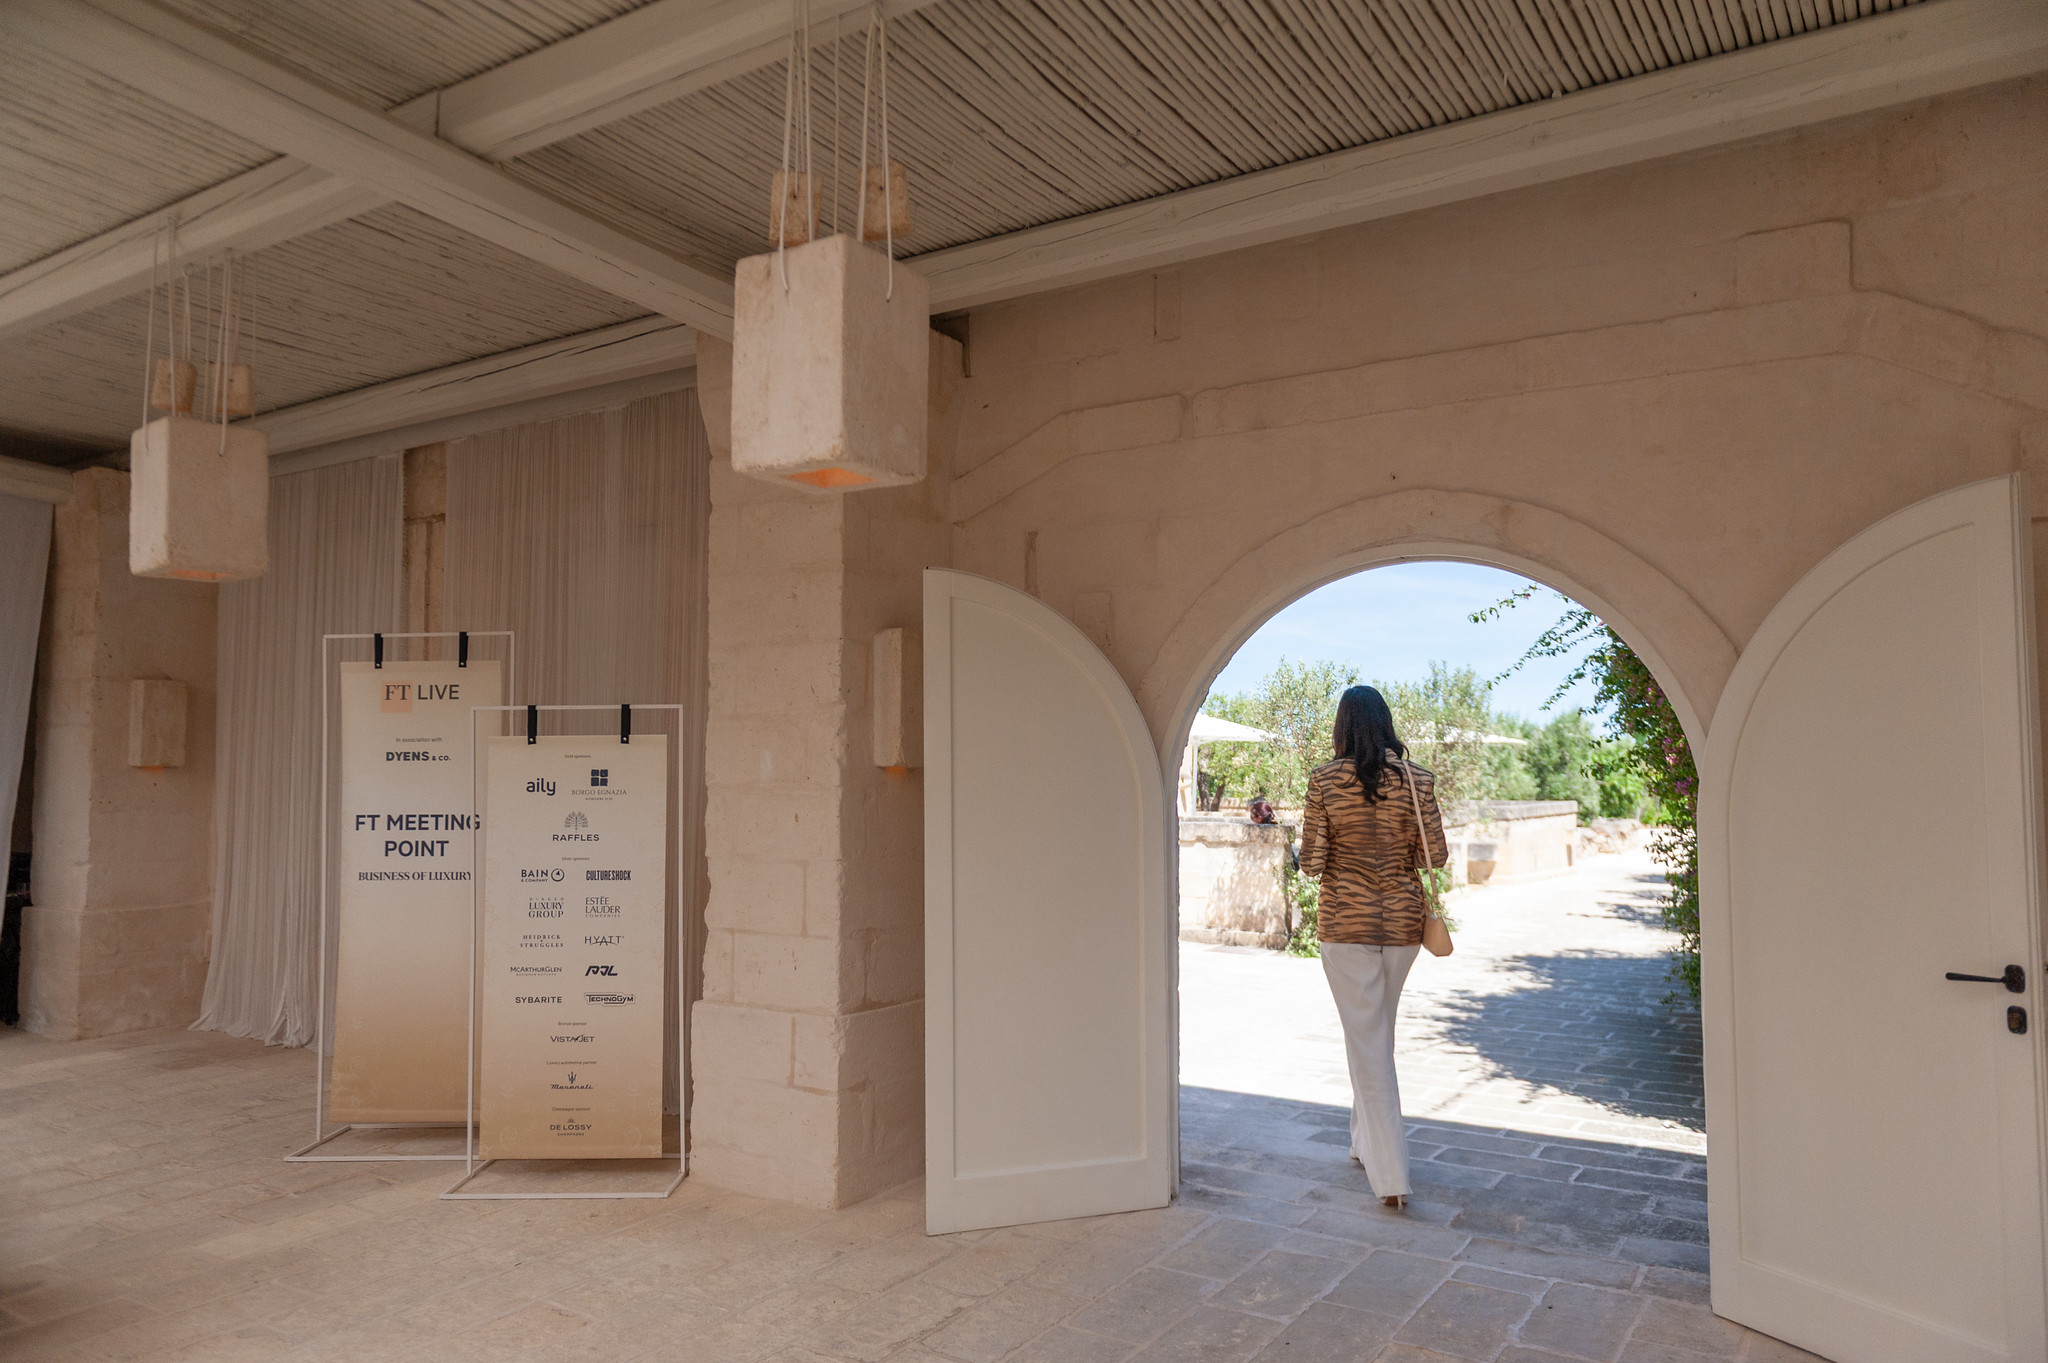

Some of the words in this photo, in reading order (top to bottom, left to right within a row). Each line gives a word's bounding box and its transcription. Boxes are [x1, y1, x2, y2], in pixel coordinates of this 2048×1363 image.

[384, 684, 411, 700] FT
[417, 684, 460, 700] LIVE
[385, 751, 429, 761] DYENS
[526, 777, 556, 796] aily
[355, 814, 380, 831] FT
[387, 814, 480, 831] MEETING
[552, 834, 600, 842] RAFFLES
[384, 840, 449, 857] POINT
[358, 871, 410, 881] BUSINESS
[412, 871, 427, 881] OF
[428, 871, 471, 881] LUXURY
[521, 869, 548, 878] BAIN
[586, 870, 631, 881] CULTURESHOCK
[529, 902, 564, 910] LUXURY
[585, 906, 621, 914] LAUDER
[584, 936, 621, 946] HYATT
